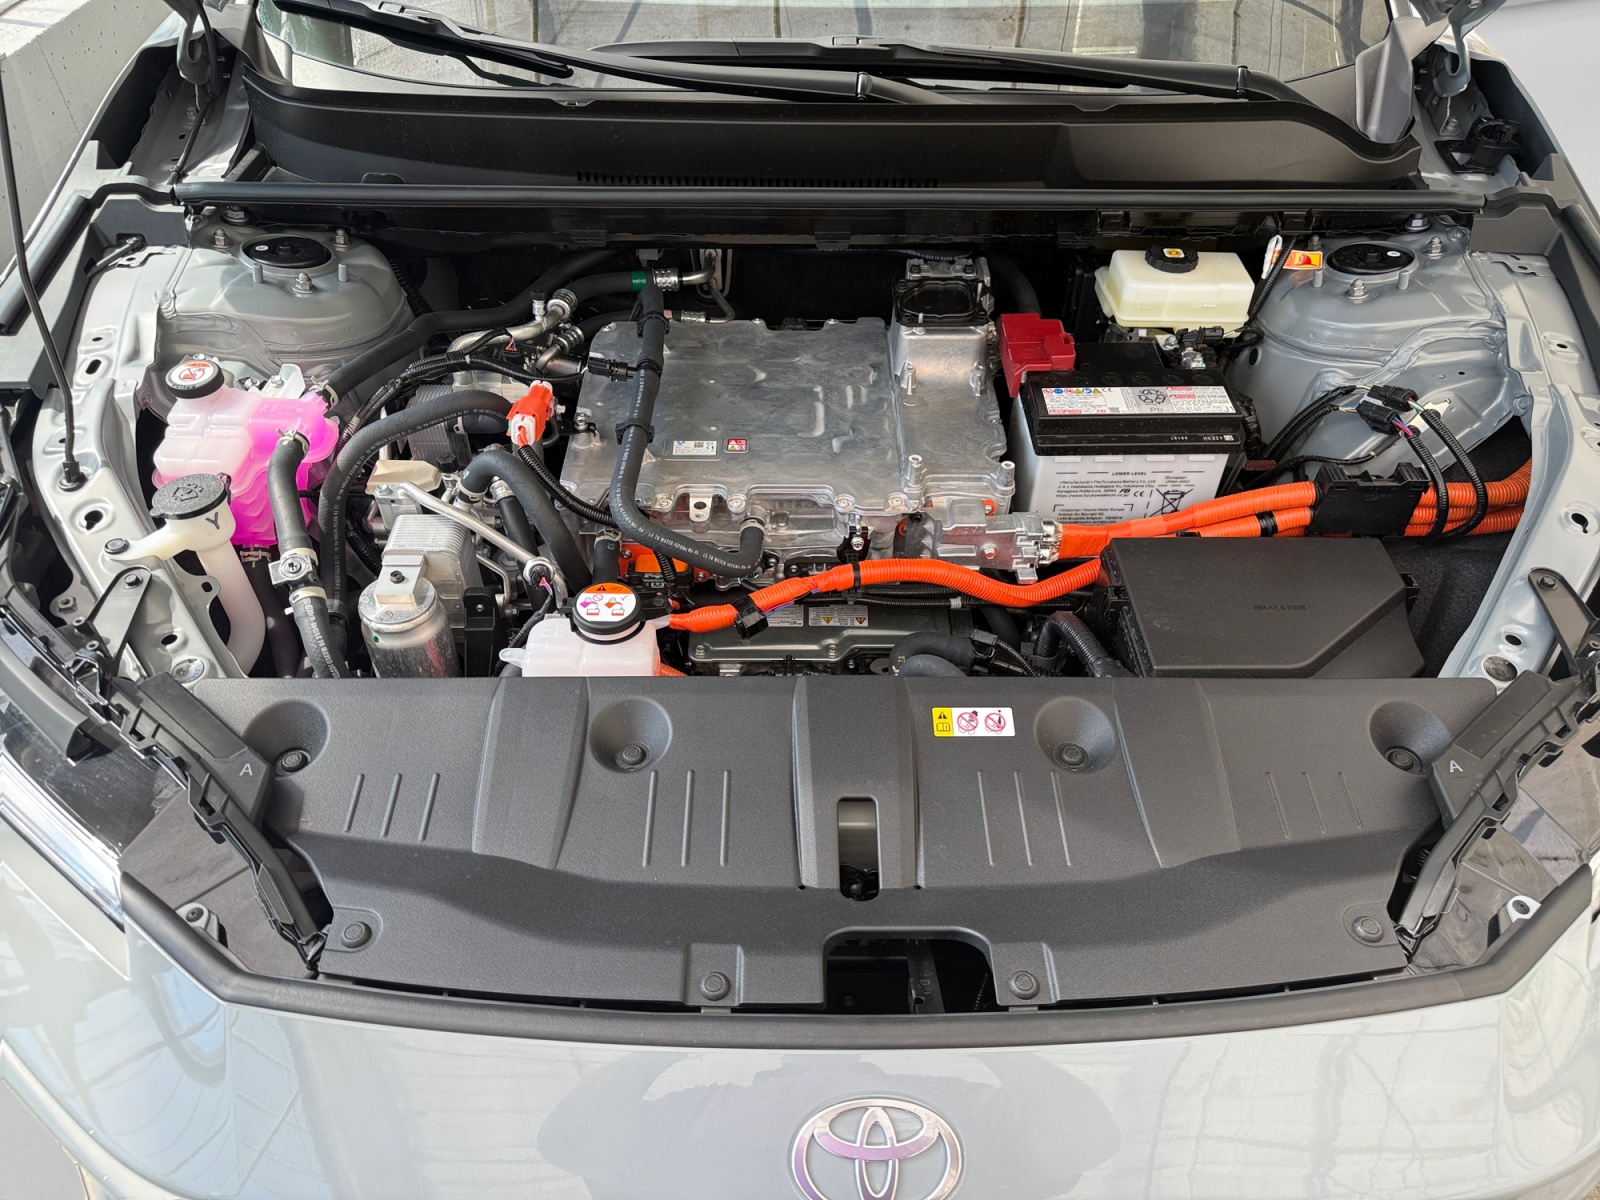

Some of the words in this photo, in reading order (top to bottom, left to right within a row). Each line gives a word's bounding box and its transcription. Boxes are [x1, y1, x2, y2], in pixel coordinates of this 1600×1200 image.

[205, 512, 220, 530] Y
[321, 646, 333, 664] WATER
[239, 763, 253, 776] A
[1450, 760, 1464, 773] A
